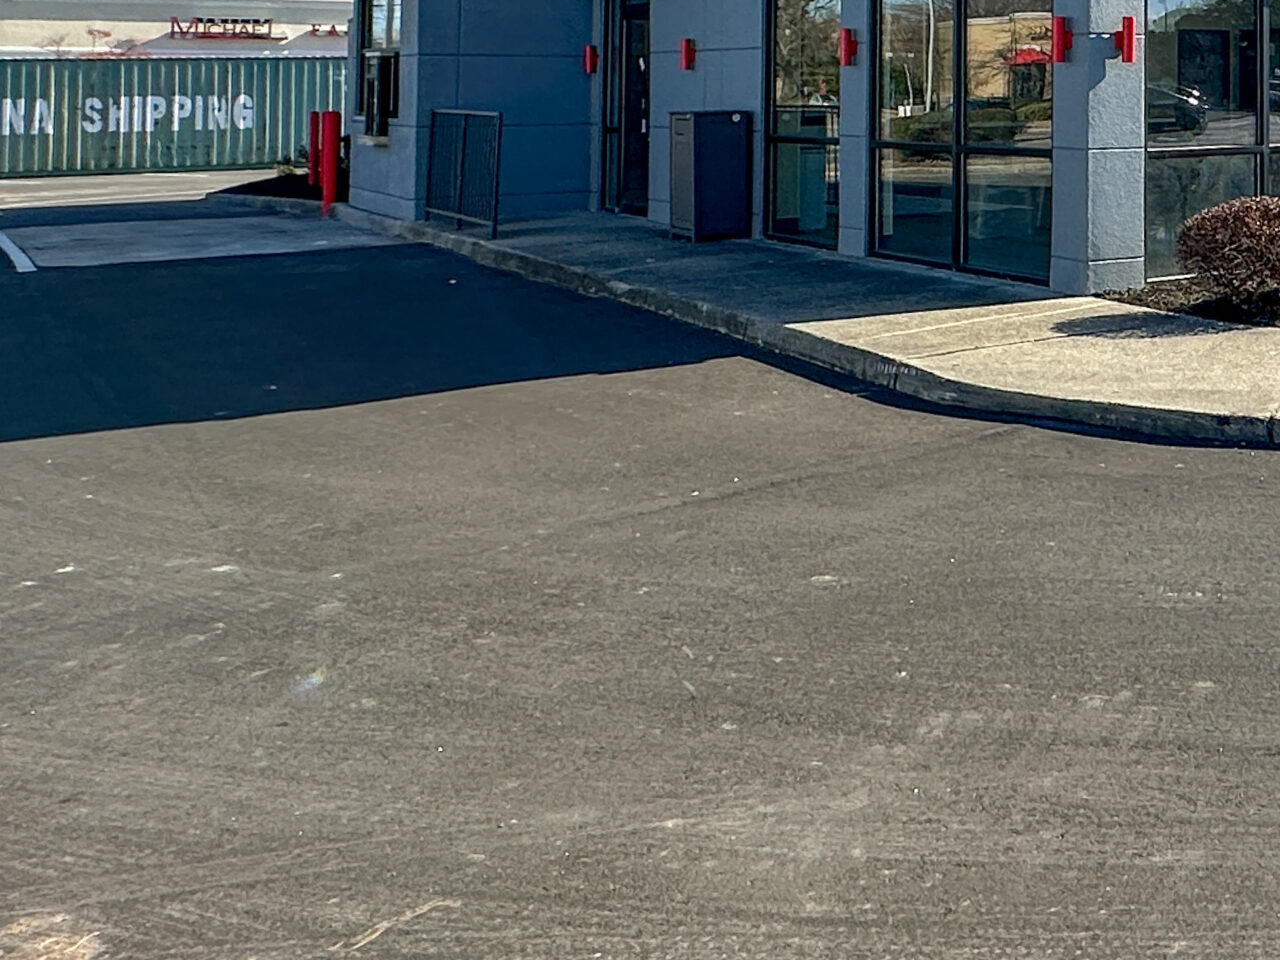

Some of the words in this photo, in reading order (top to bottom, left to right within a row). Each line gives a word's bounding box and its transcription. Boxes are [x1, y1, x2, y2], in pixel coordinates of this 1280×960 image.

[310, 24, 348, 37] EA
[2, 97, 54, 136] NA
[82, 93, 254, 134] SHIPPING
